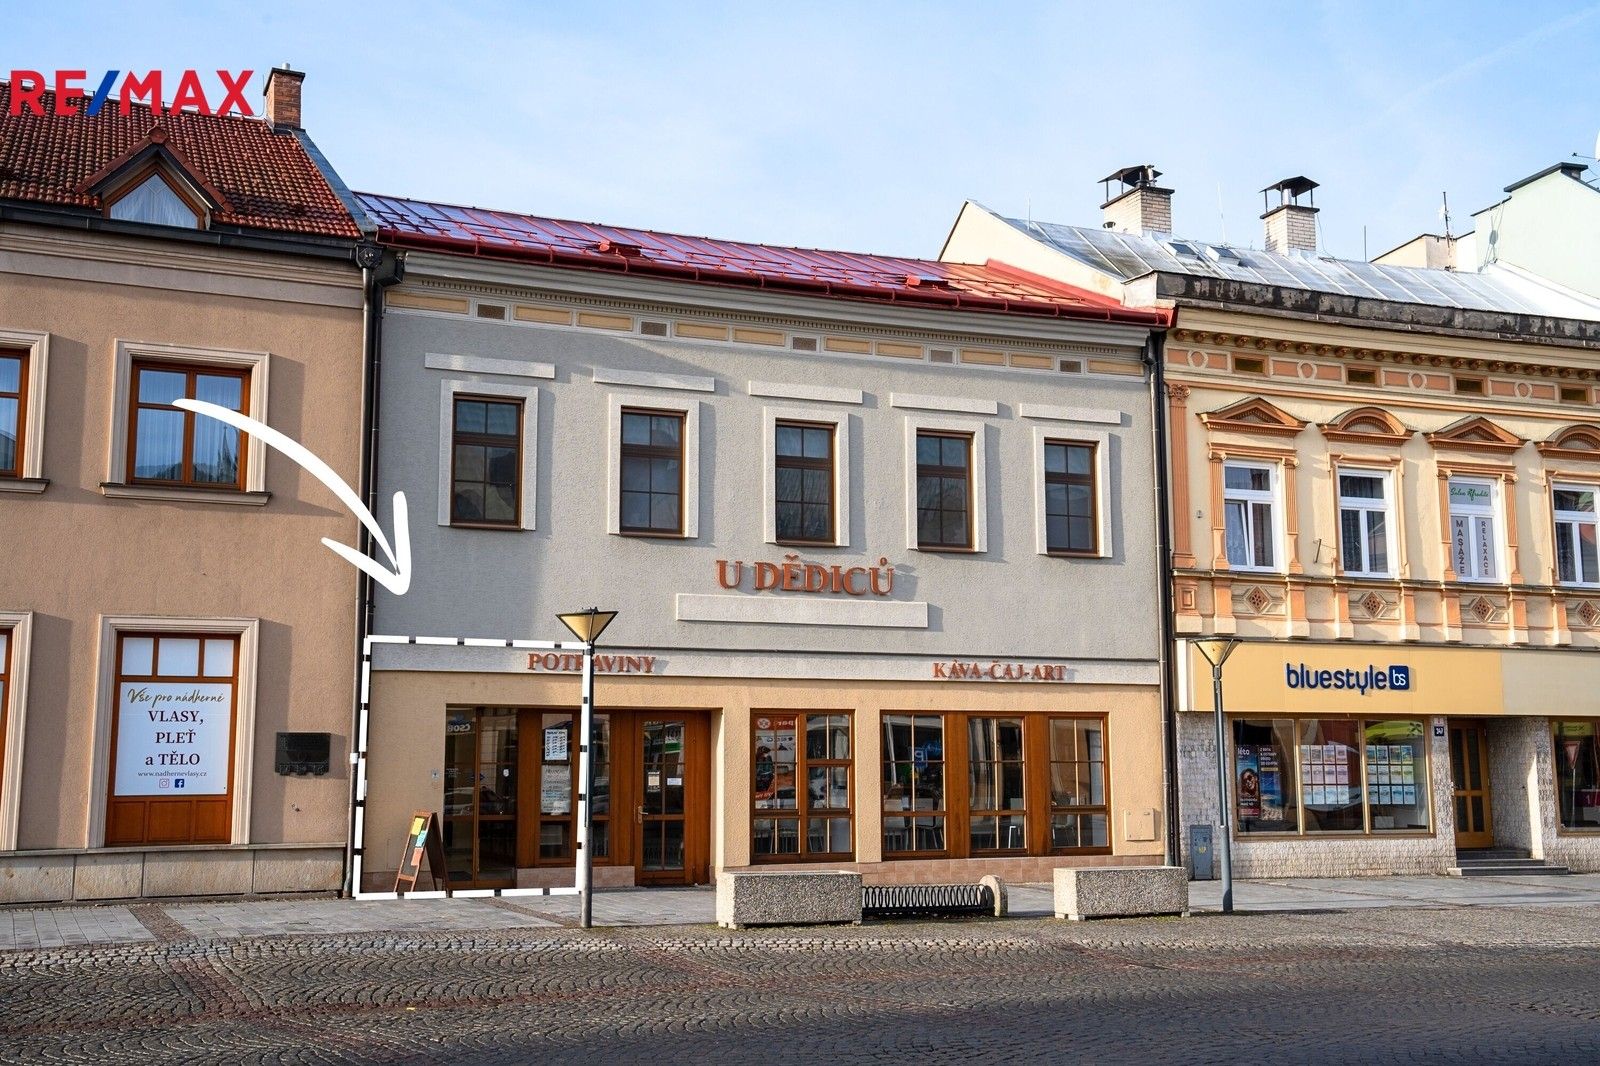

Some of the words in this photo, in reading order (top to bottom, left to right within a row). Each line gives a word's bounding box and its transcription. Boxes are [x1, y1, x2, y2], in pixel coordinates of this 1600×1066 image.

[1481, 520, 1489, 575] RELAXACE
[715, 559, 743, 590] U
[753, 554, 896, 596] DĚDICŮ
[1285, 662, 1387, 695] bluestyle
[1392, 669, 1406, 687] bs
[127, 687, 152, 704] Vše
[151, 693, 173, 708] pro
[174, 688, 225, 704] nádherné
[148, 710, 205, 725] VLASY,
[155, 729, 197, 744] PLEŤ
[145, 755, 154, 766] a
[158, 750, 201, 766] TĚLO
[137, 770, 208, 779] www.nadhernevlasy.cz
